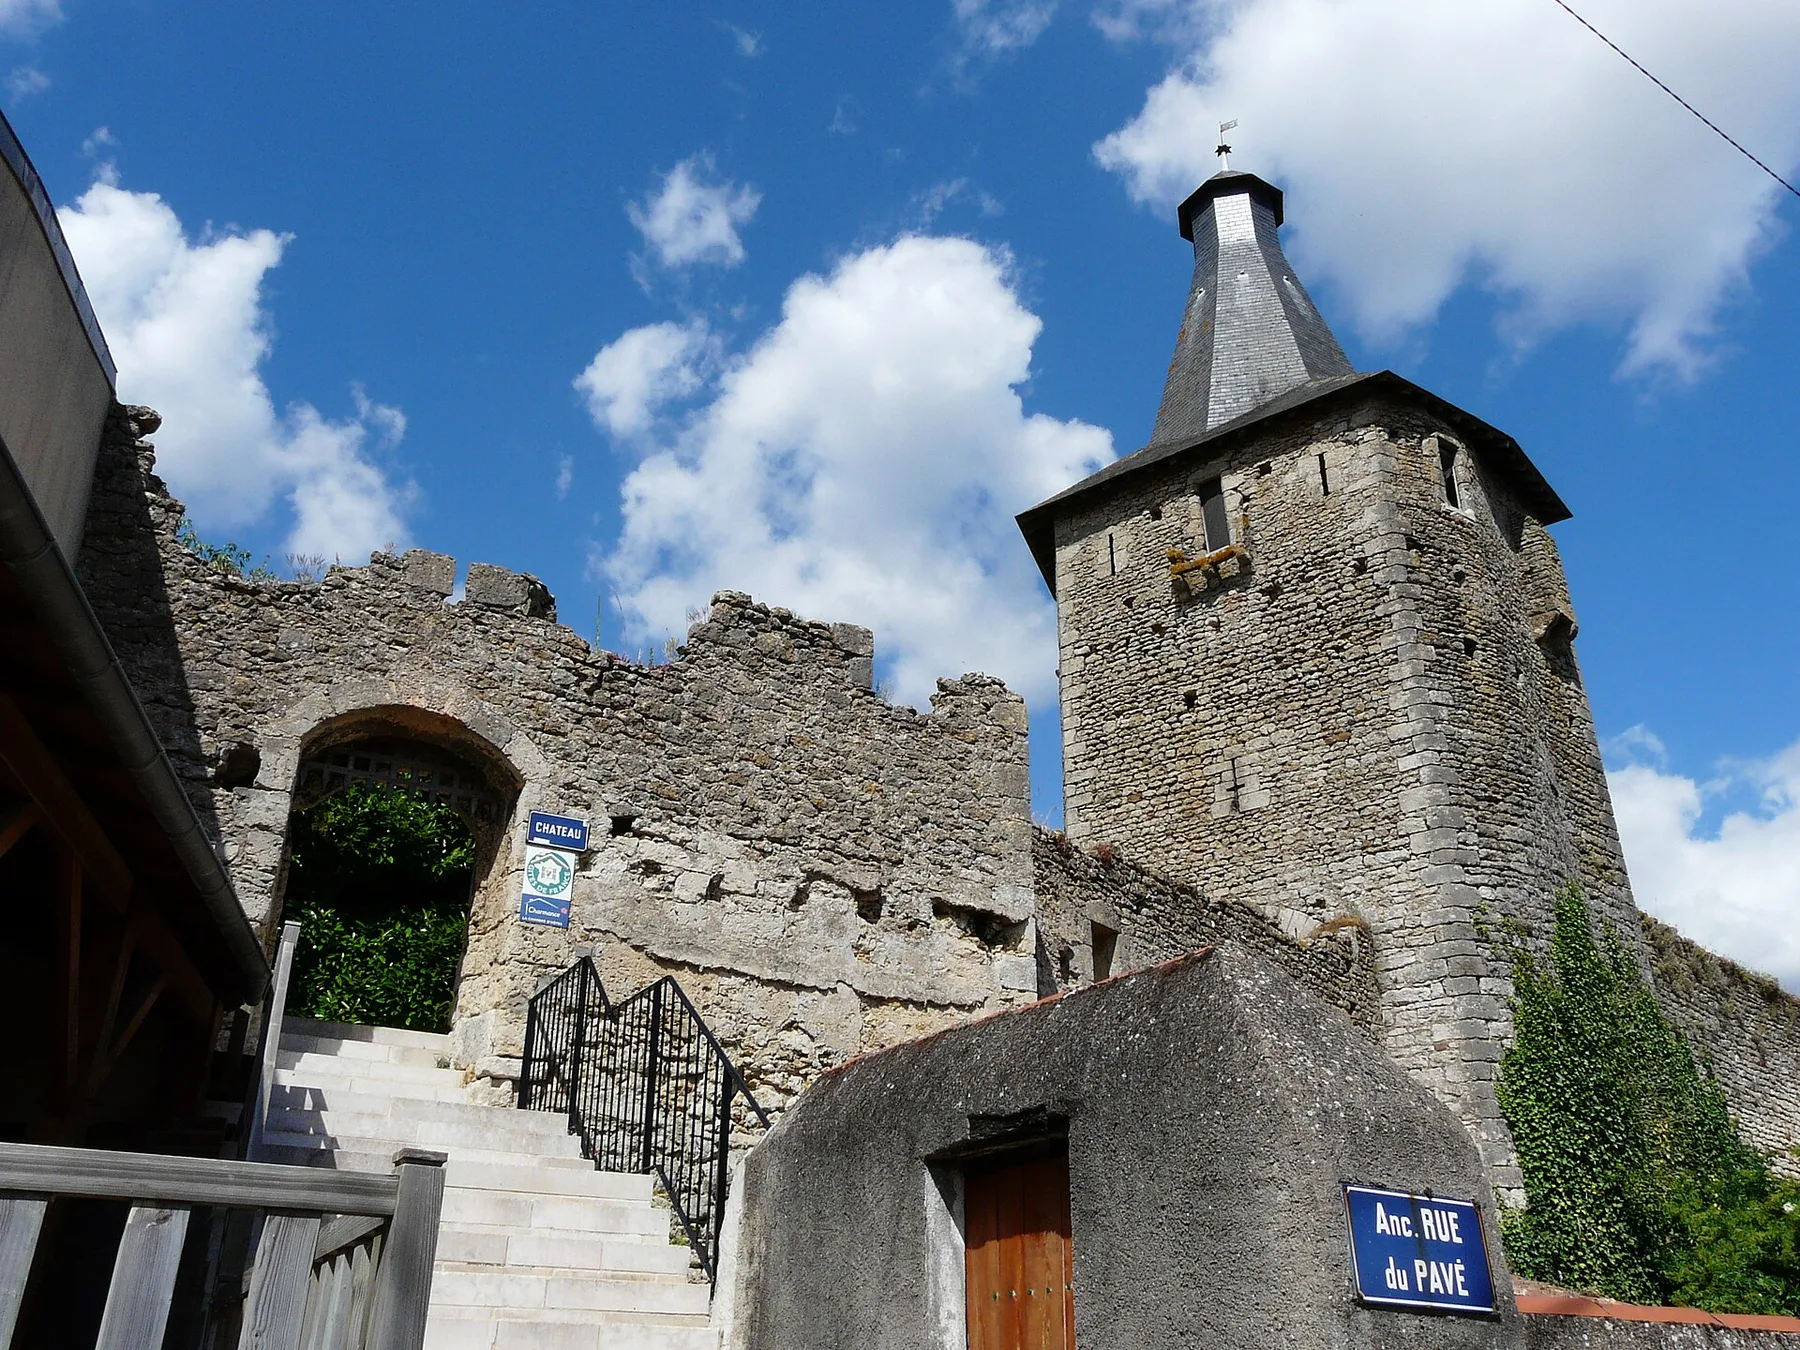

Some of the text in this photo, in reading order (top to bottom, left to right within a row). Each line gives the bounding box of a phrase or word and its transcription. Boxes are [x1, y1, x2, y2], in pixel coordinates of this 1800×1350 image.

[535, 821, 581, 840] CHATEAU
[537, 884, 548, 894] DE
[549, 871, 570, 894] FRANCE
[528, 906, 561, 918] Charmance
[1376, 1202, 1463, 1244] Anc. RUE
[1385, 1256, 1469, 1297] du PAVÉ
